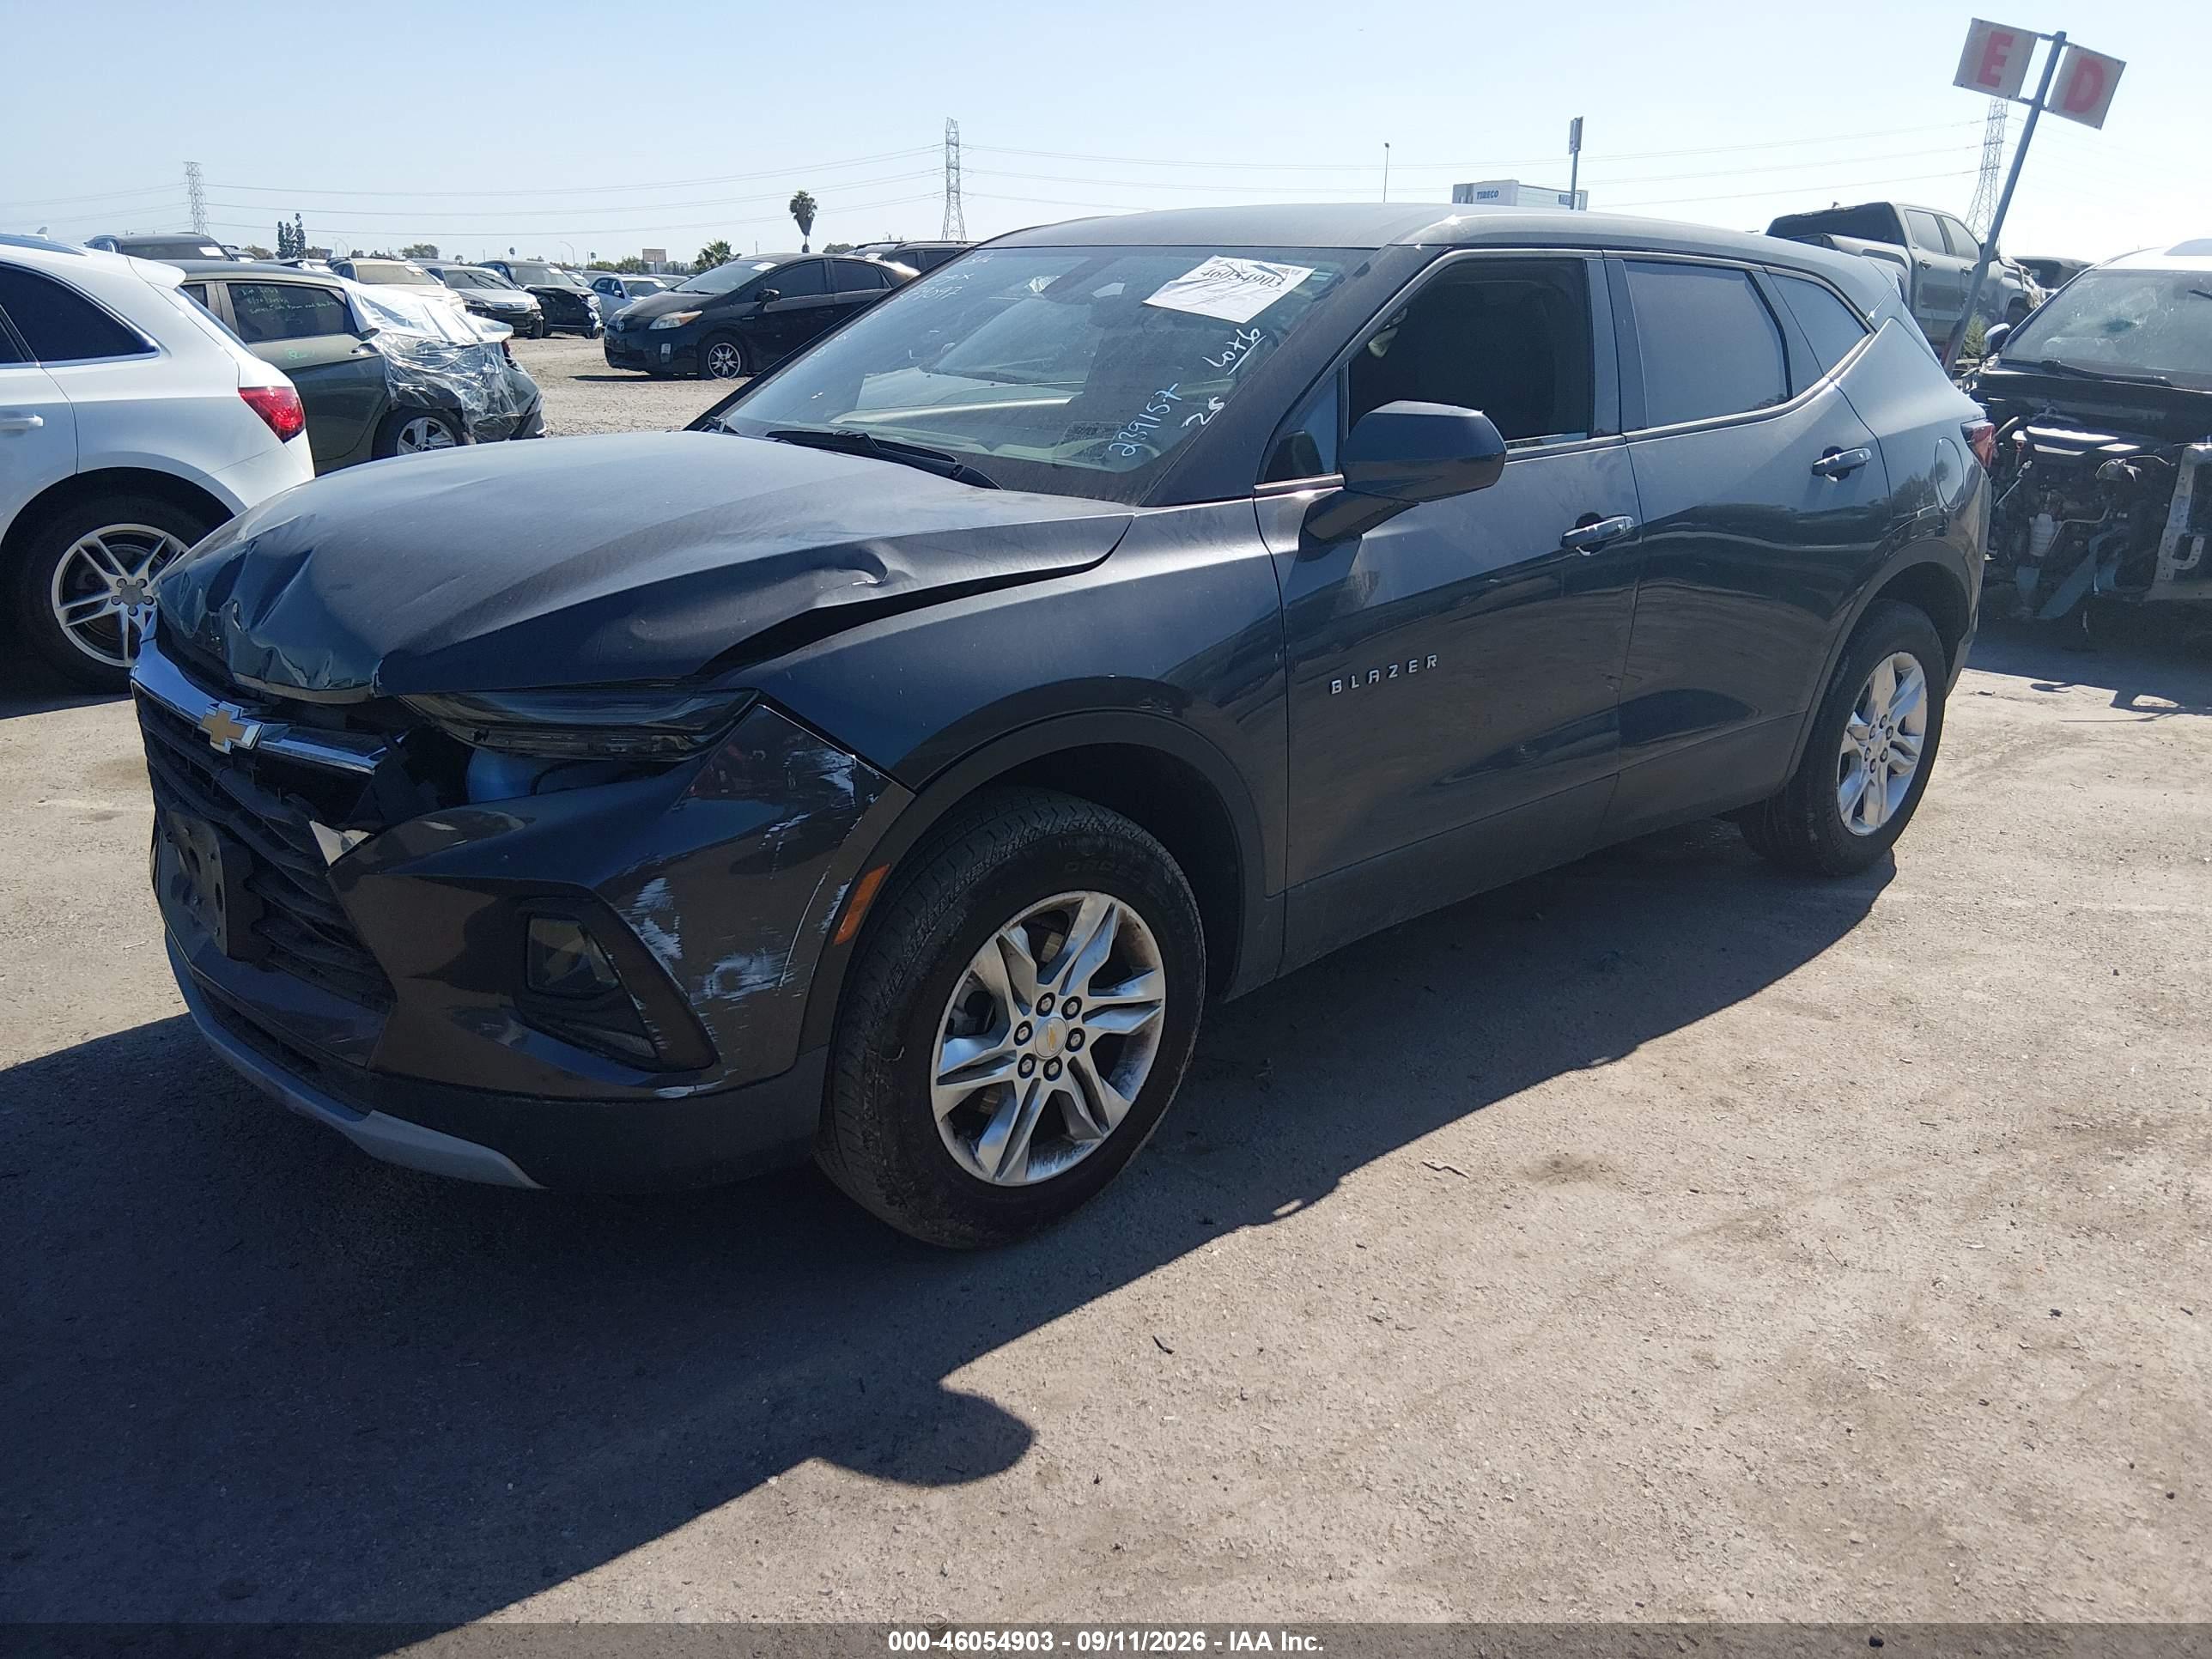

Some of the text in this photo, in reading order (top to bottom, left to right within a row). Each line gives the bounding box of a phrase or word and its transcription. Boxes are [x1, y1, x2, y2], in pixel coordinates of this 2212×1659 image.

[1976, 30, 2014, 88] E
[2063, 55, 2105, 113] D
[1330, 653, 1438, 695] BLAZER
